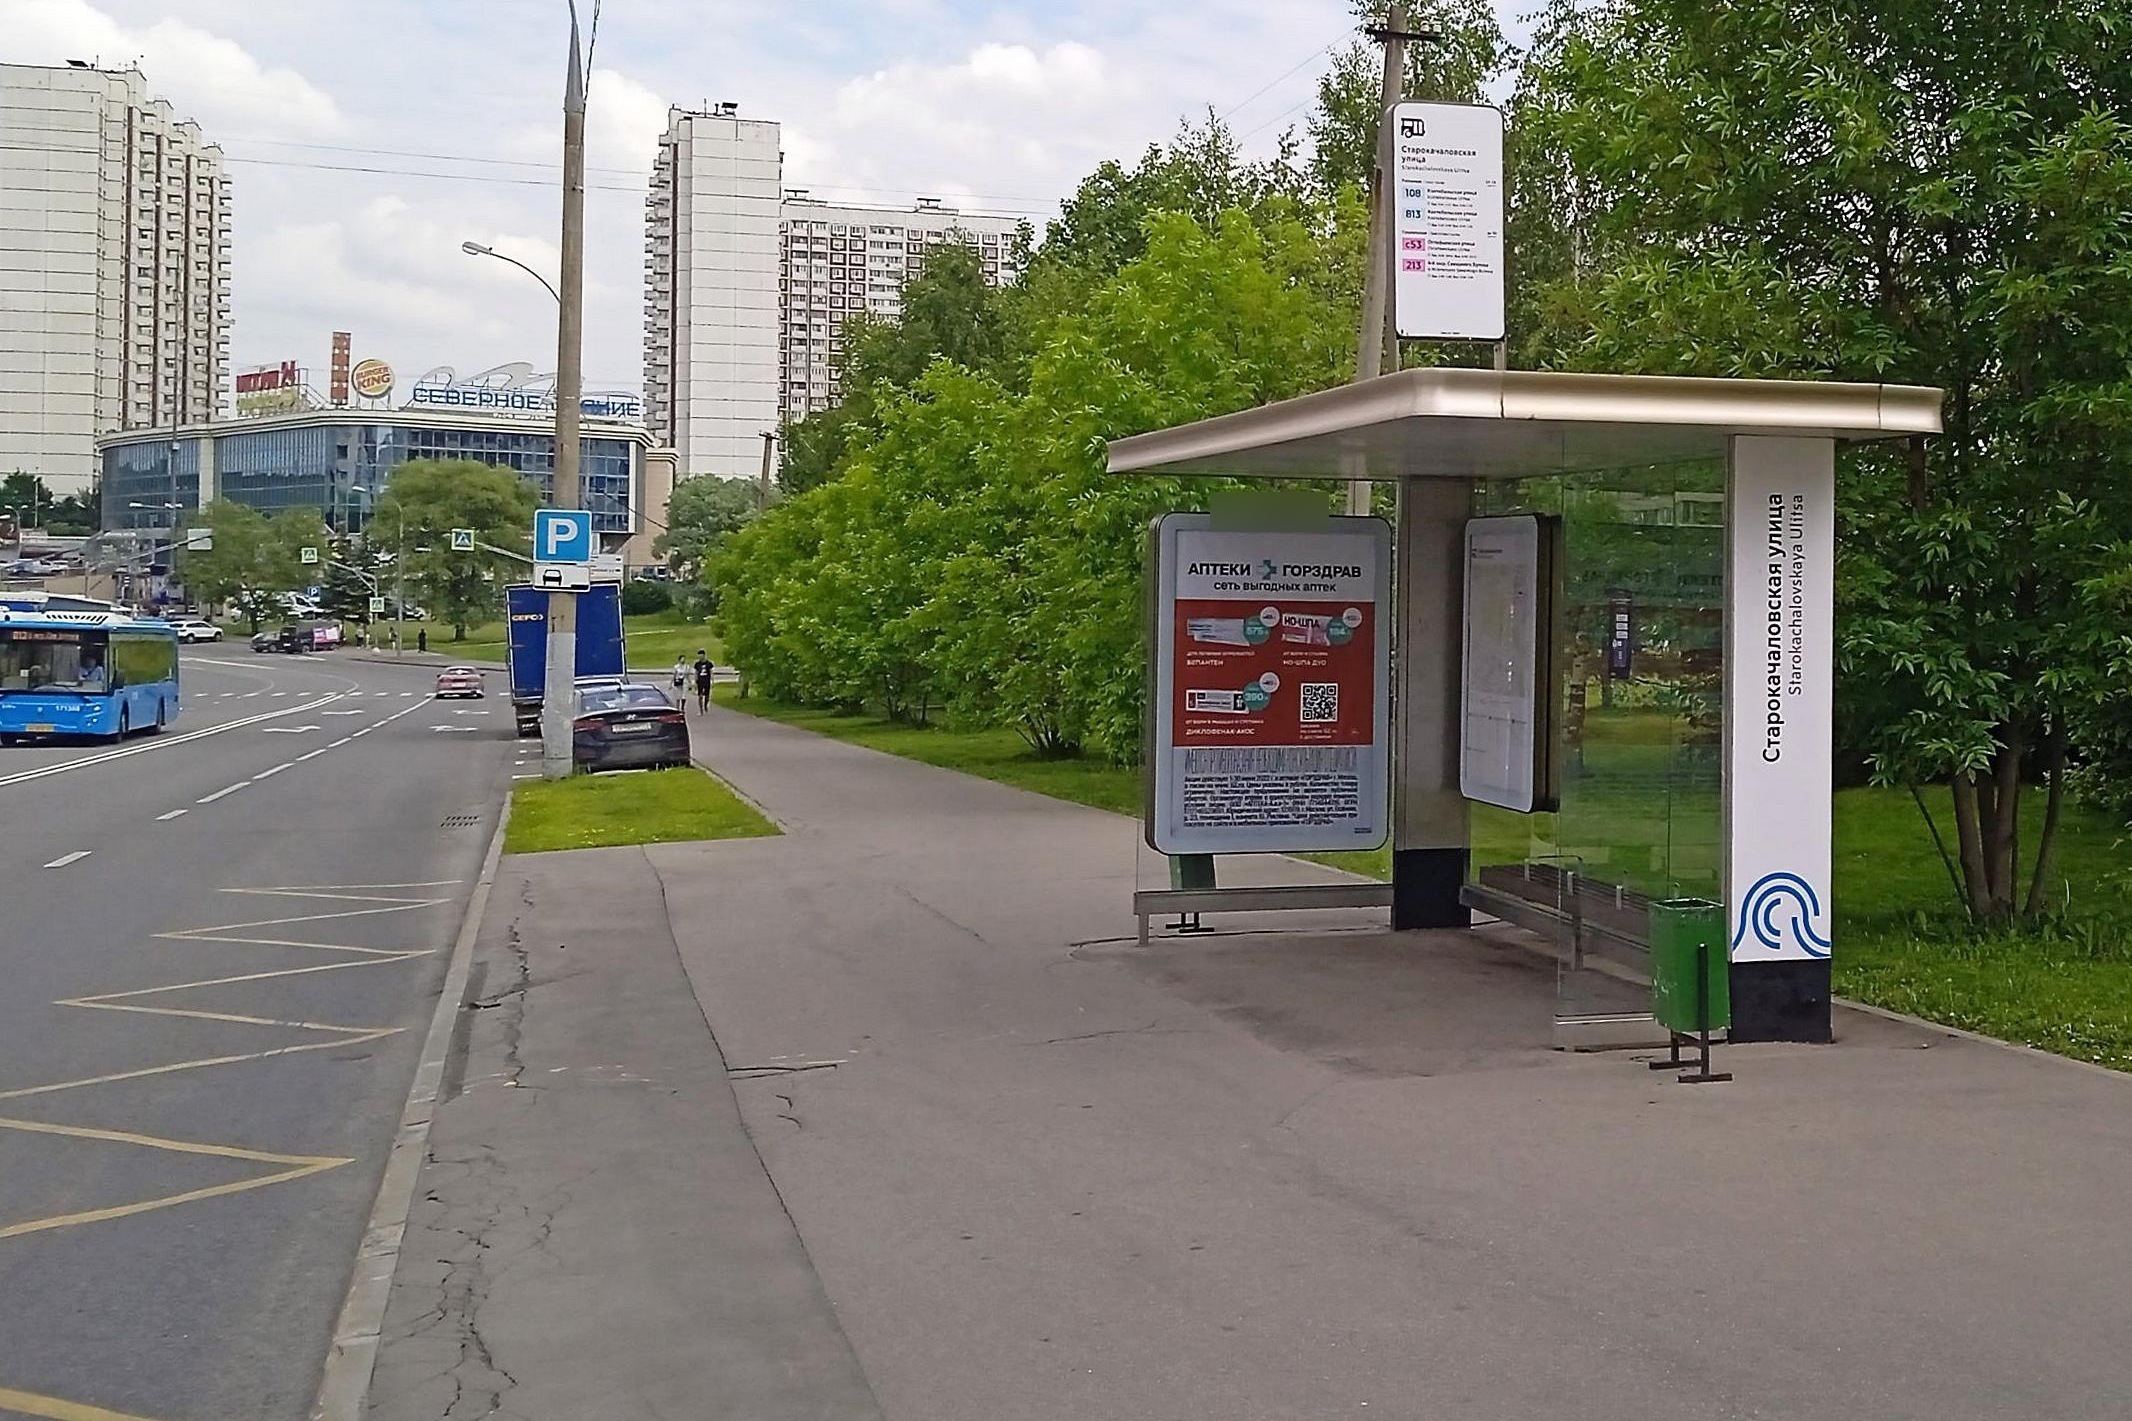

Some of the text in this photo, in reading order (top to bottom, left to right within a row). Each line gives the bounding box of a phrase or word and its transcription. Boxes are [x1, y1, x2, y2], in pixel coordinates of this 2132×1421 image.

[1405, 188, 1421, 198] 108
[1405, 209, 1421, 219] 813
[1406, 260, 1421, 270] 213
[356, 366, 389, 381] BURGER
[358, 374, 391, 390] KING
[413, 388, 541, 410] СЕВЕРНОЕ
[1187, 562, 1362, 580] АПТЕКИ ГОРЗДРАВ
[1213, 581, 1337, 593] сеть выгодных аптек
[1788, 494, 1806, 695] Starokachalovskaya Ulitsa
[1284, 616, 1321, 628] НО-ШПА
[1762, 494, 1786, 763] Старокачаловская улица
